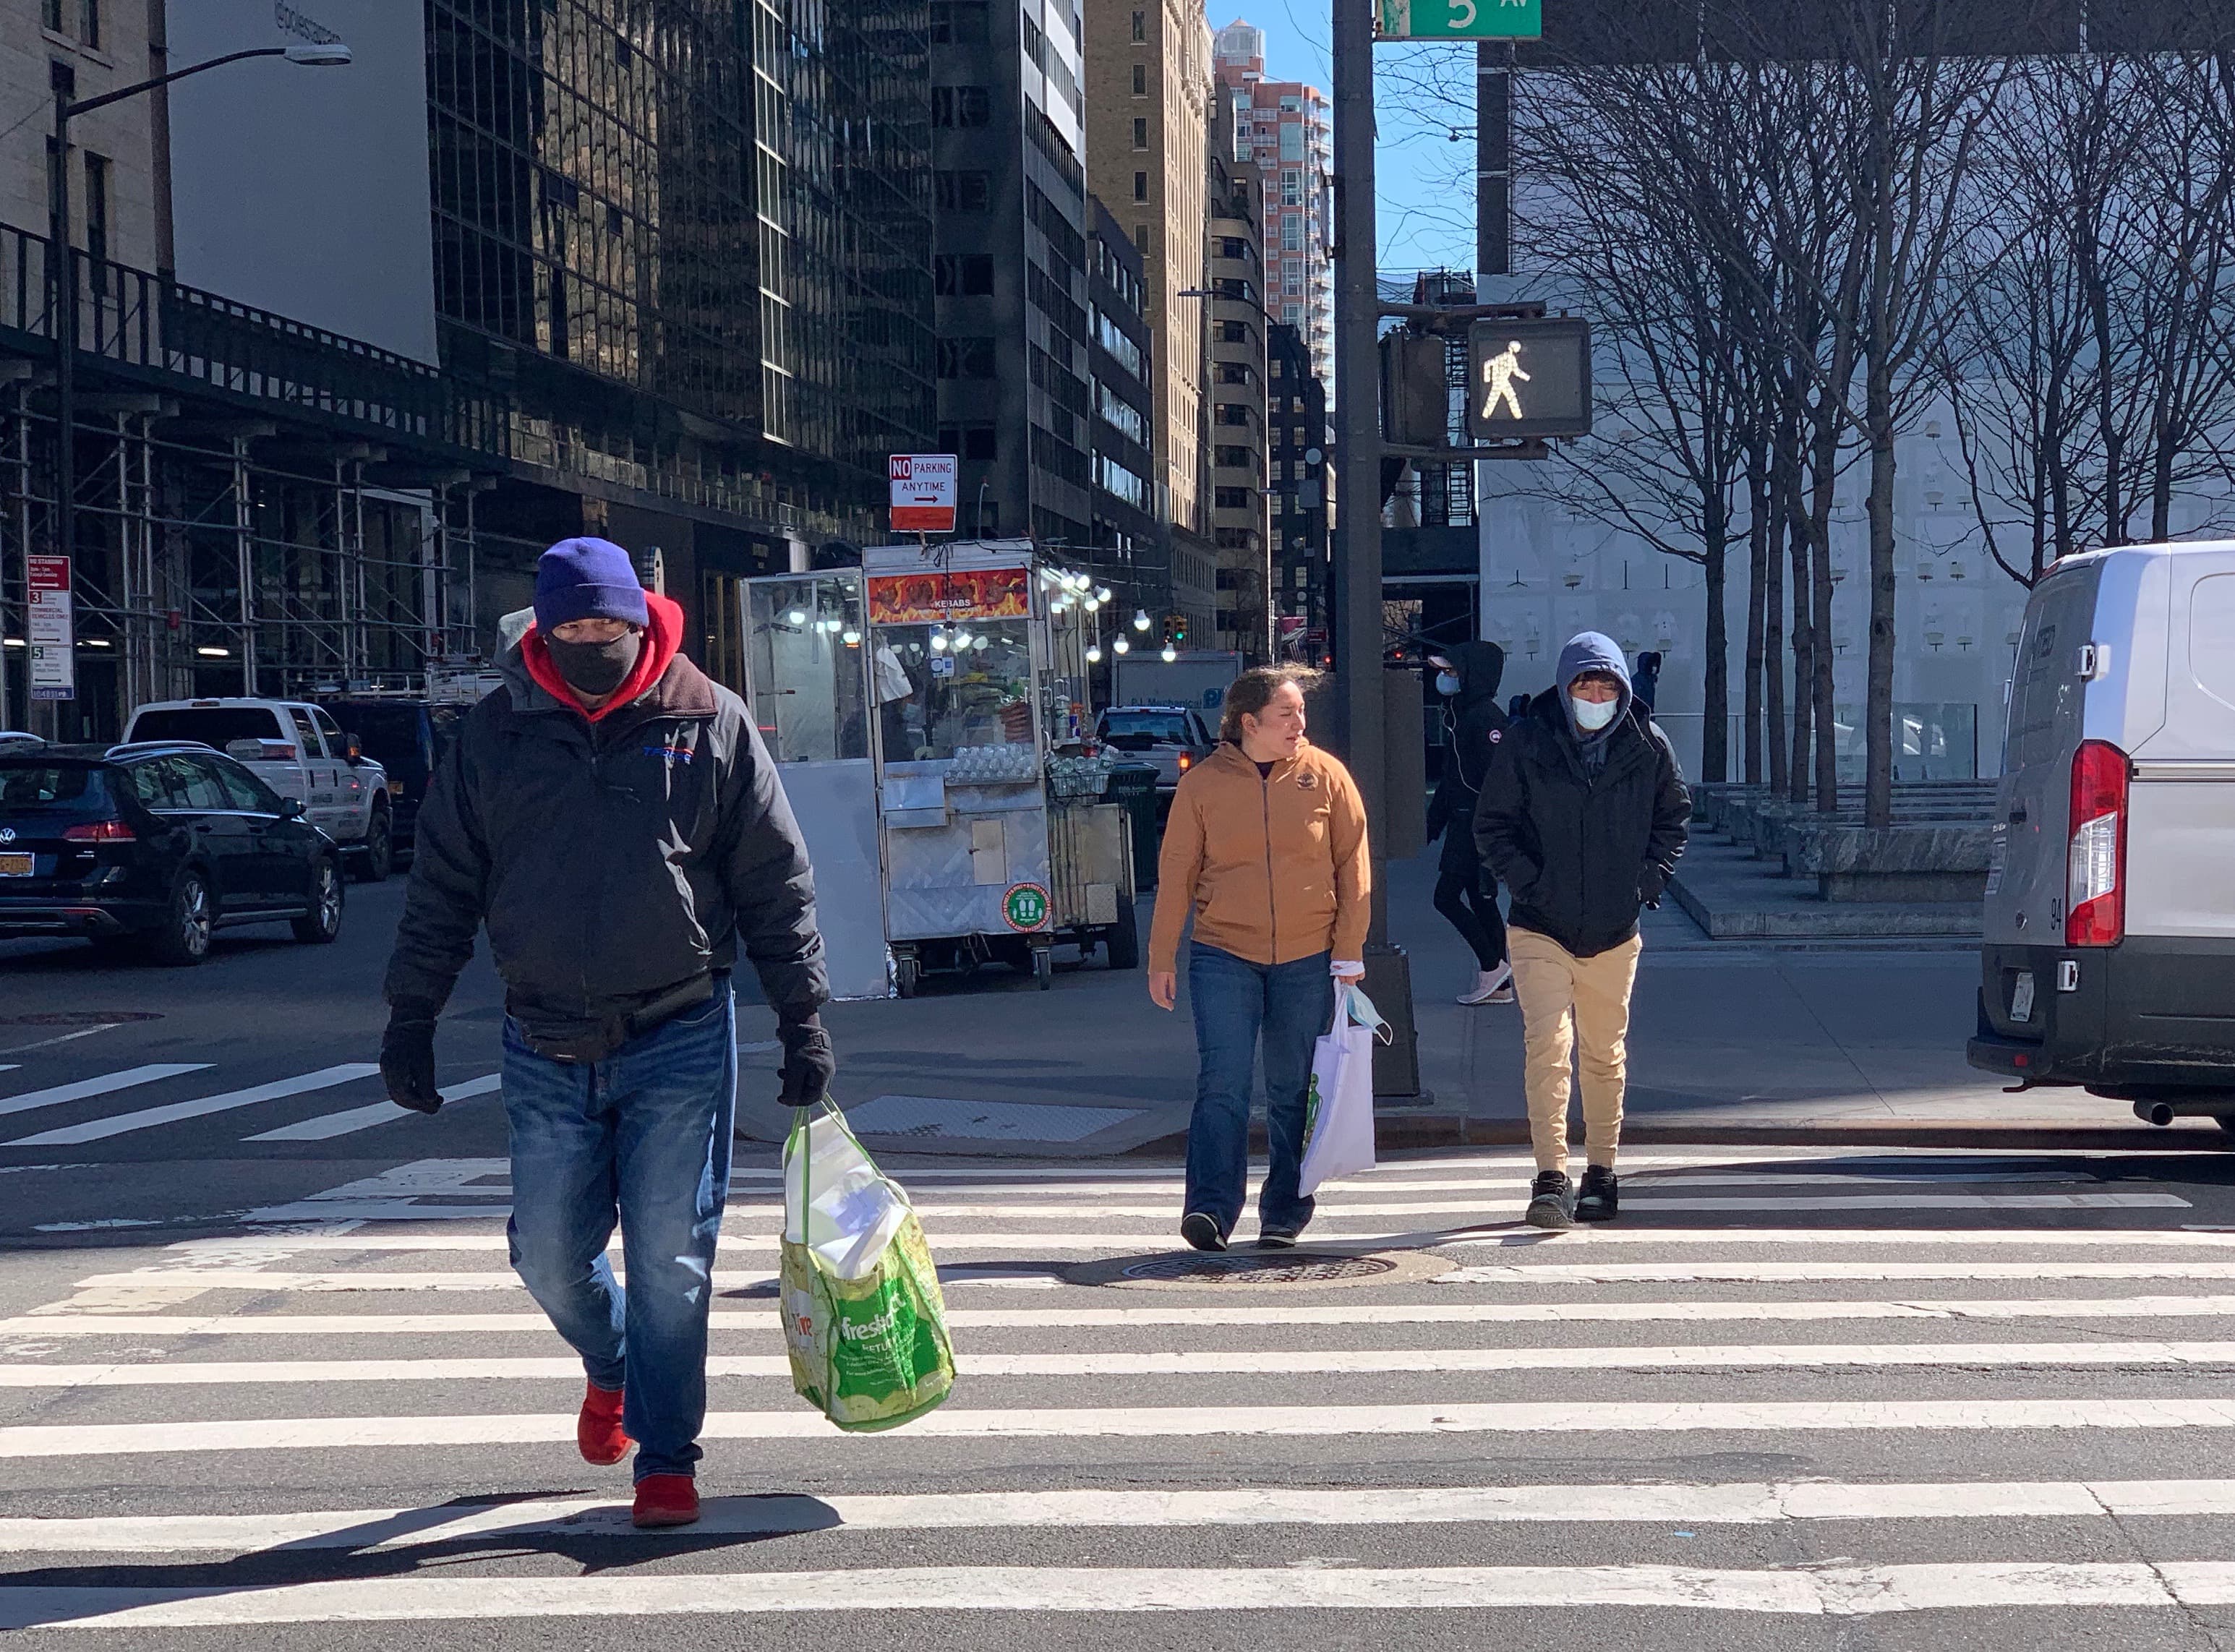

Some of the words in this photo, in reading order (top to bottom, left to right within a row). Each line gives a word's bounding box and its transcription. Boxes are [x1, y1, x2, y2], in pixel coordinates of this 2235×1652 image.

[1448, 0, 1477, 28] 5
[892, 460, 911, 477] NO
[914, 463, 952, 474] PARKING
[902, 482, 946, 492] ANYTIME
[32, 592, 40, 603] 3
[933, 599, 971, 608] KEBABS
[33, 647, 41, 659] 5
[2051, 897, 2062, 931] 94
